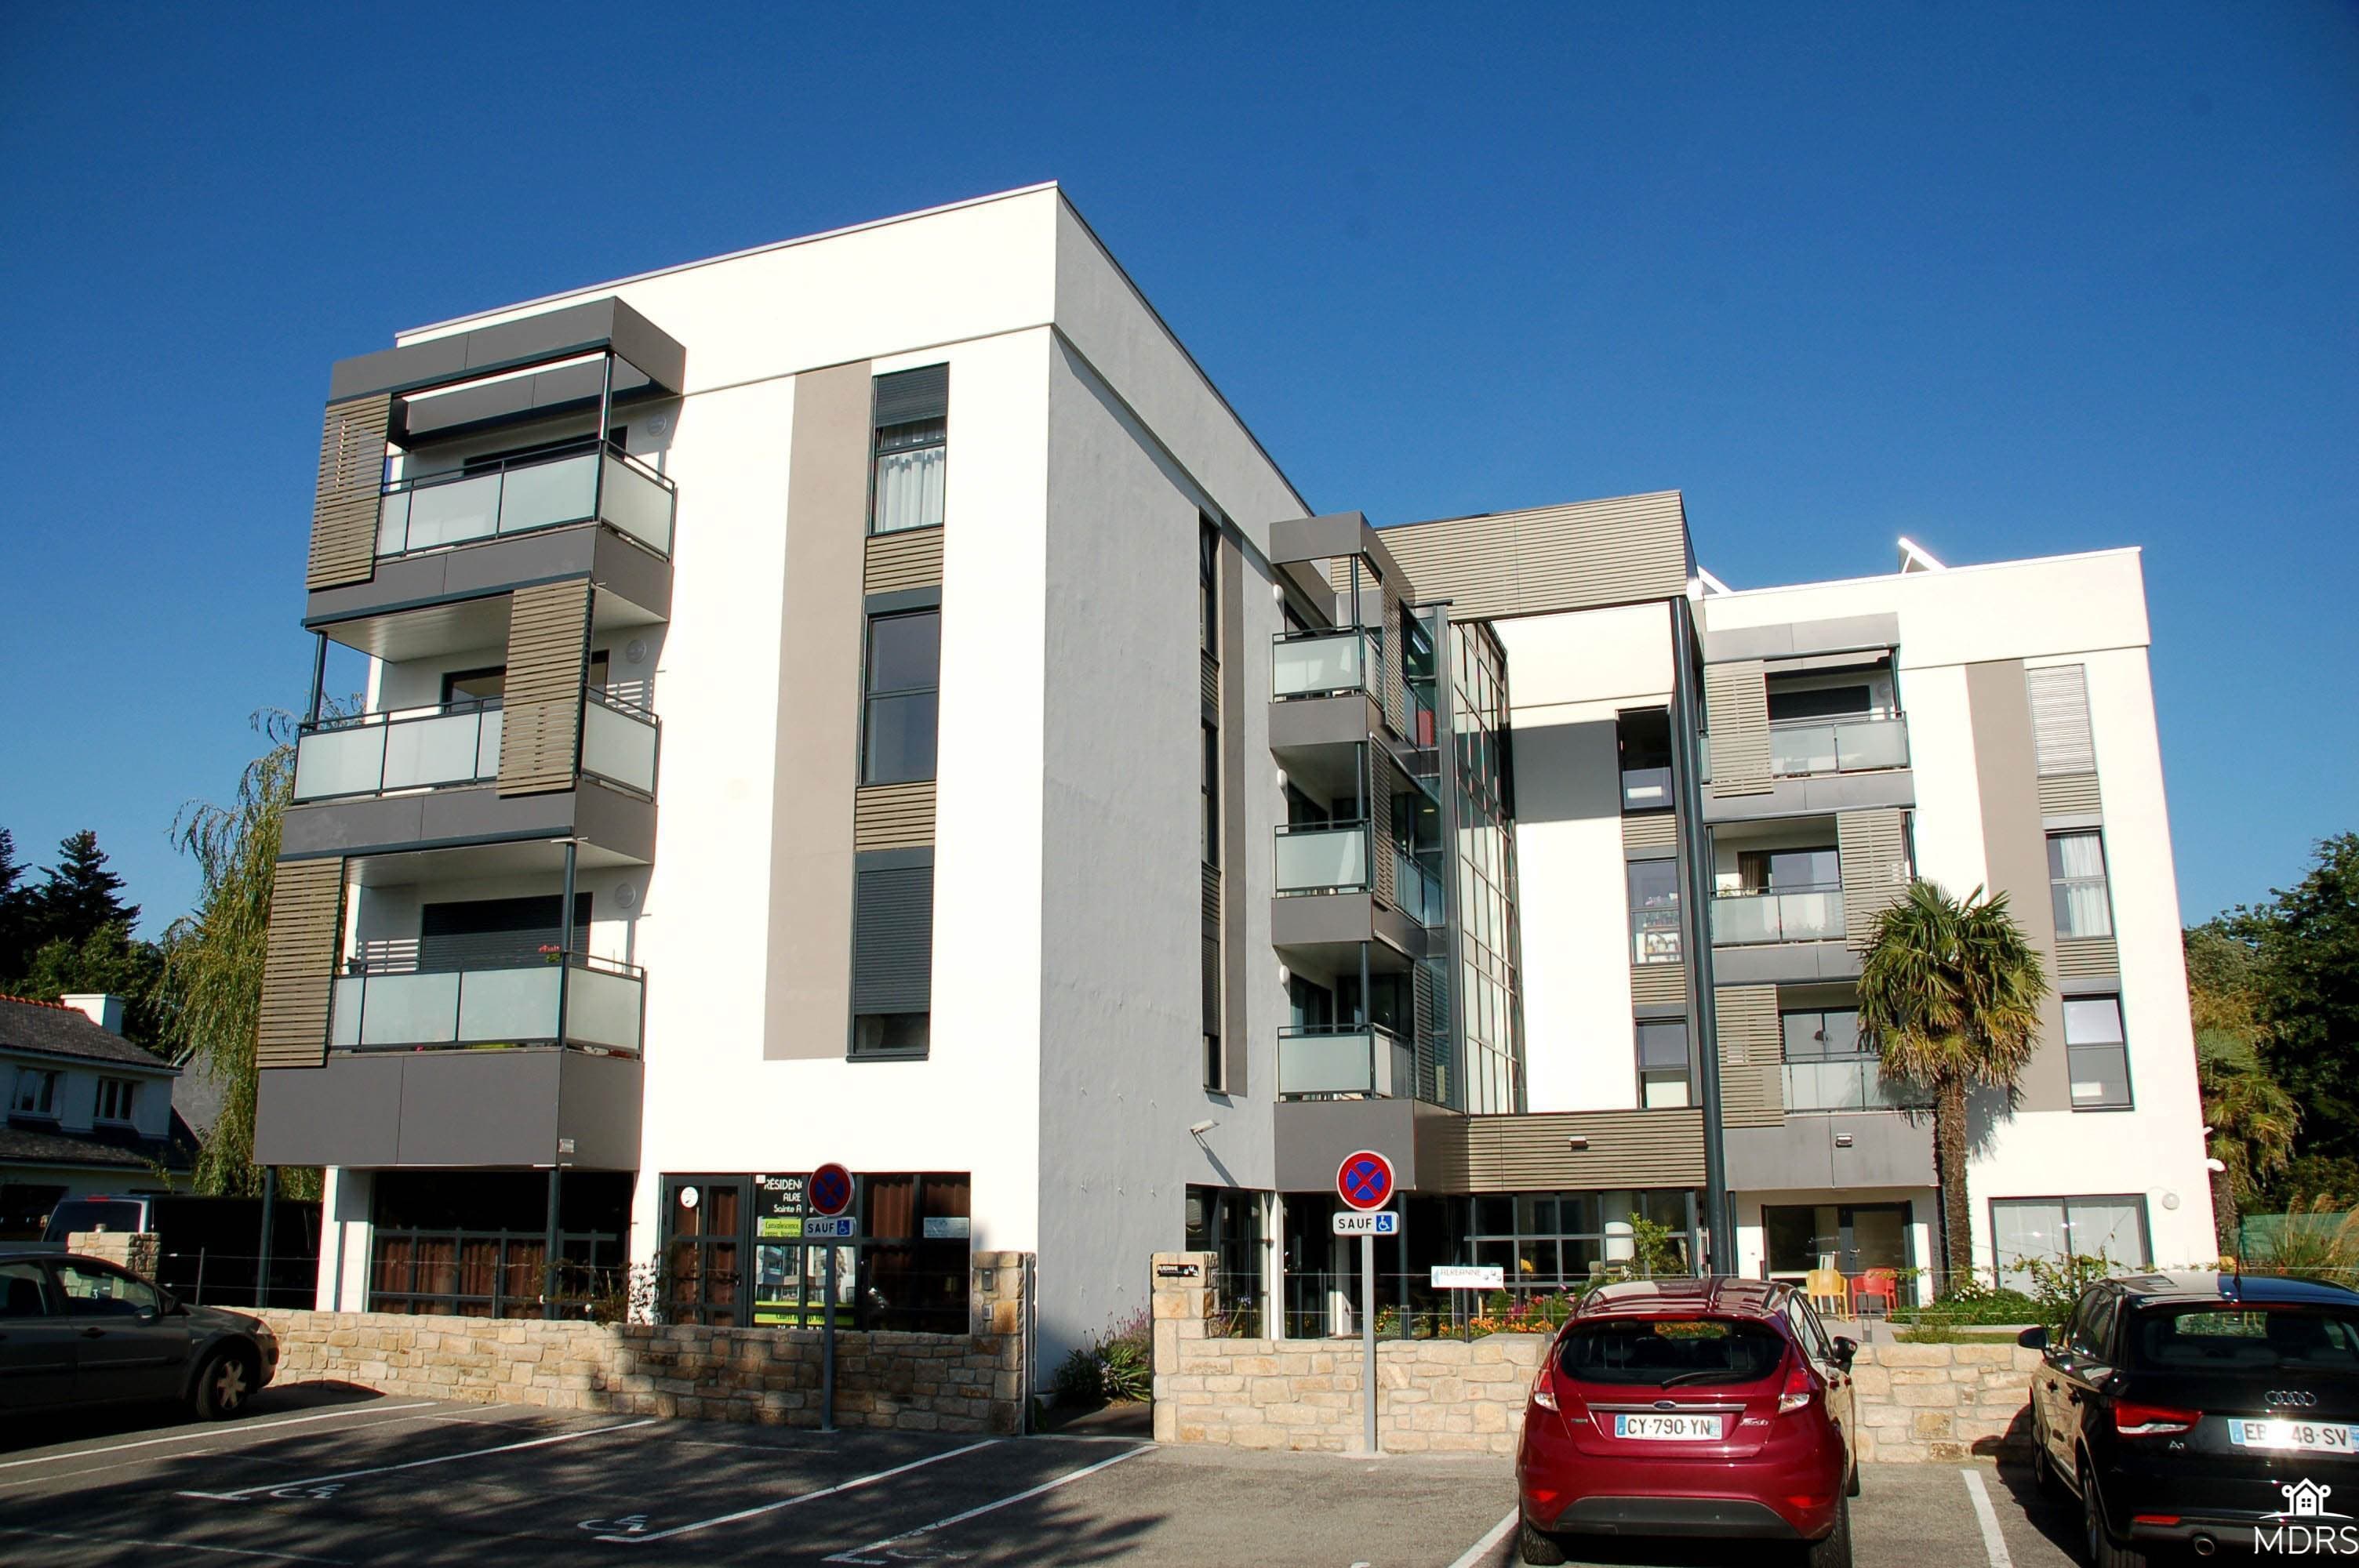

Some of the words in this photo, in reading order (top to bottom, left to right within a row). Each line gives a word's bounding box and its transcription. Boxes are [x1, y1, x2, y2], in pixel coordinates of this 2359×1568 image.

[773, 1203, 794, 1213] Sainte
[808, 1223, 834, 1233] SAUF
[1339, 1218, 1372, 1229] SAUF
